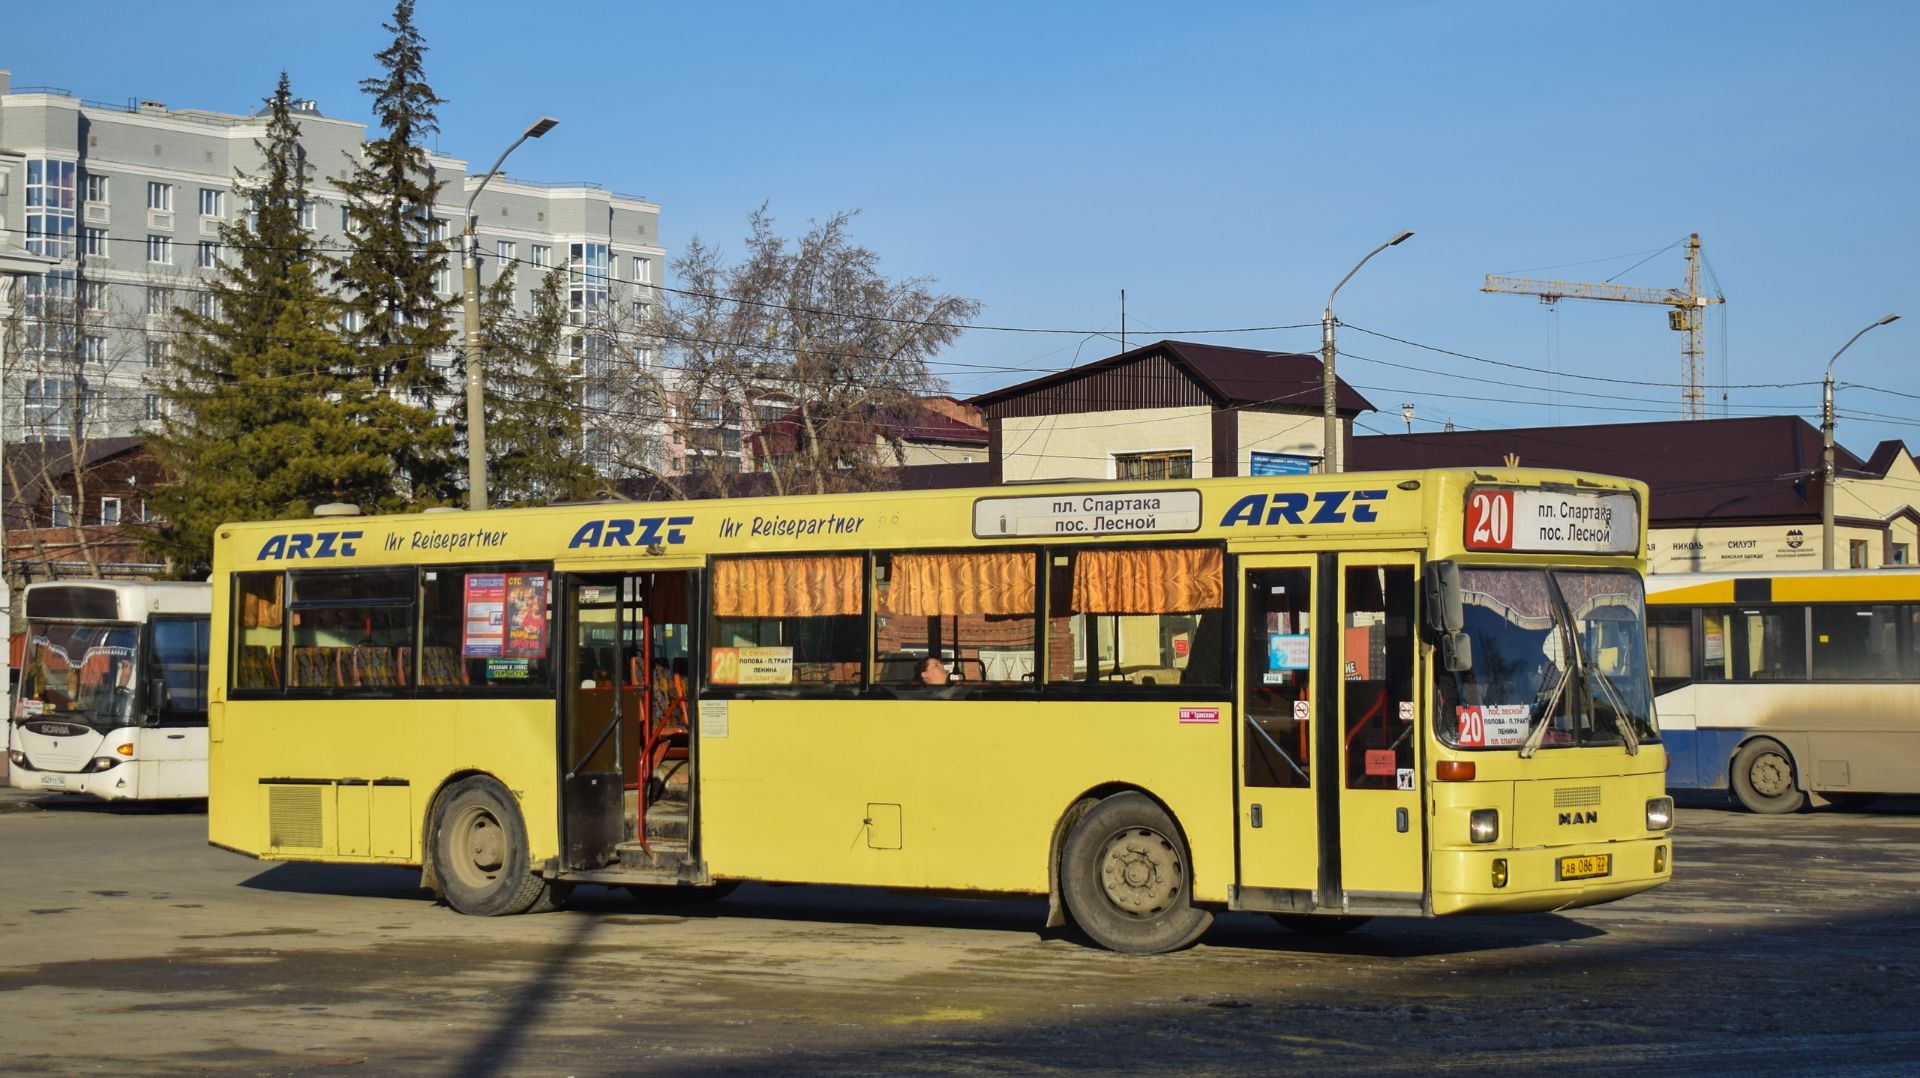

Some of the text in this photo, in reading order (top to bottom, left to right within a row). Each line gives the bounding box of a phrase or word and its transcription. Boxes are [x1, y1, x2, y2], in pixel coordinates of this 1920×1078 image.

[1052, 496, 1161, 517] пл. Спартака
[1538, 501, 1612, 523] пл. Спартака
[719, 517, 743, 539] Ihr
[751, 513, 865, 539] Reisepartner
[1055, 515, 1156, 533] пос. Лесной
[1473, 494, 1509, 544] 20
[385, 532, 405, 551] Ihr
[411, 529, 508, 553] Reisepartner
[1539, 524, 1610, 542] пос. Лесной
[1672, 541, 1704, 551] НИКОЛЬ
[1728, 540, 1757, 549] СИЛУЭТ
[714, 651, 737, 680] 20
[41, 725, 70, 735] SCANIA
[1460, 711, 1482, 743] 20
[1558, 811, 1597, 825] MAN
[1578, 858, 1593, 873] 086
[1597, 857, 1606, 867] 22
